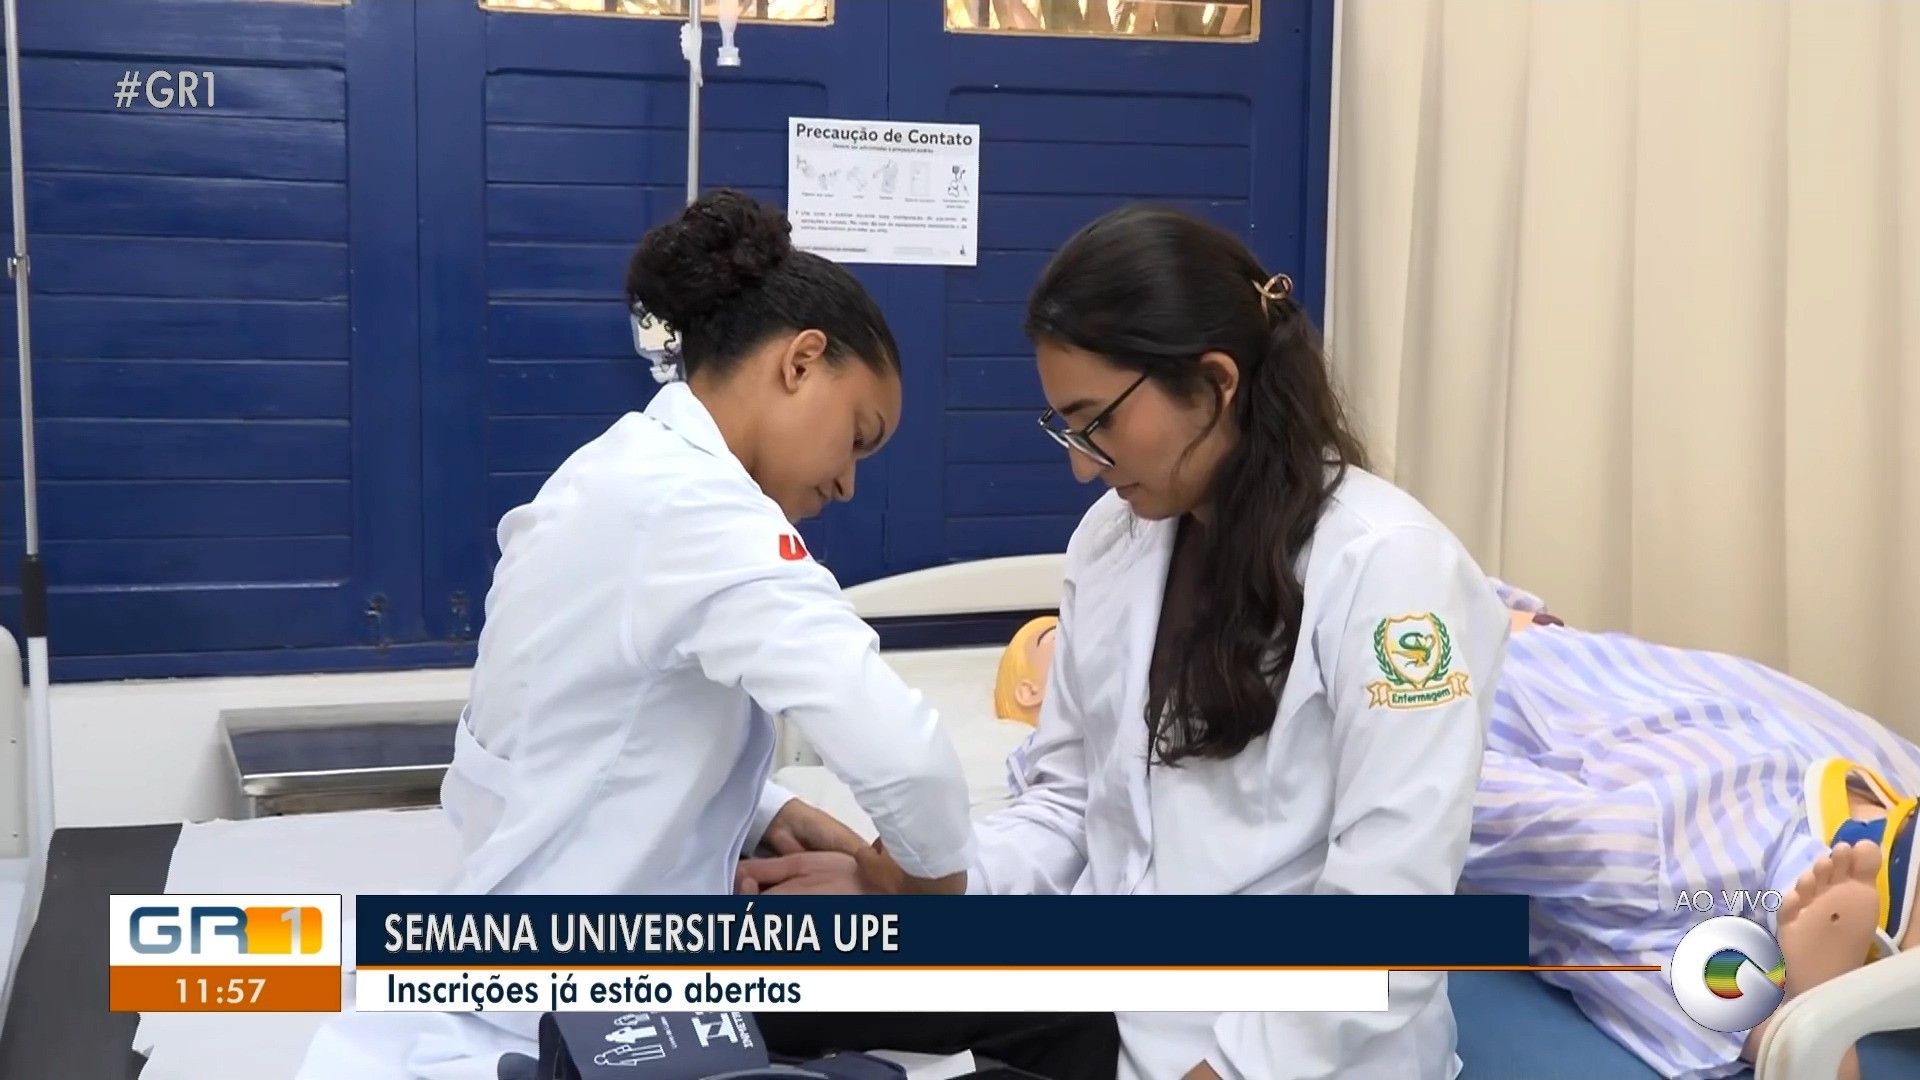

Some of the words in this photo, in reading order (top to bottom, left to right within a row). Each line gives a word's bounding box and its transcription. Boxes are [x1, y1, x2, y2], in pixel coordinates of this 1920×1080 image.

[796, 123, 878, 144] Precaução
[884, 128, 902, 142] de
[908, 129, 973, 146] Contato
[1391, 688, 1450, 704] Enfermagem
